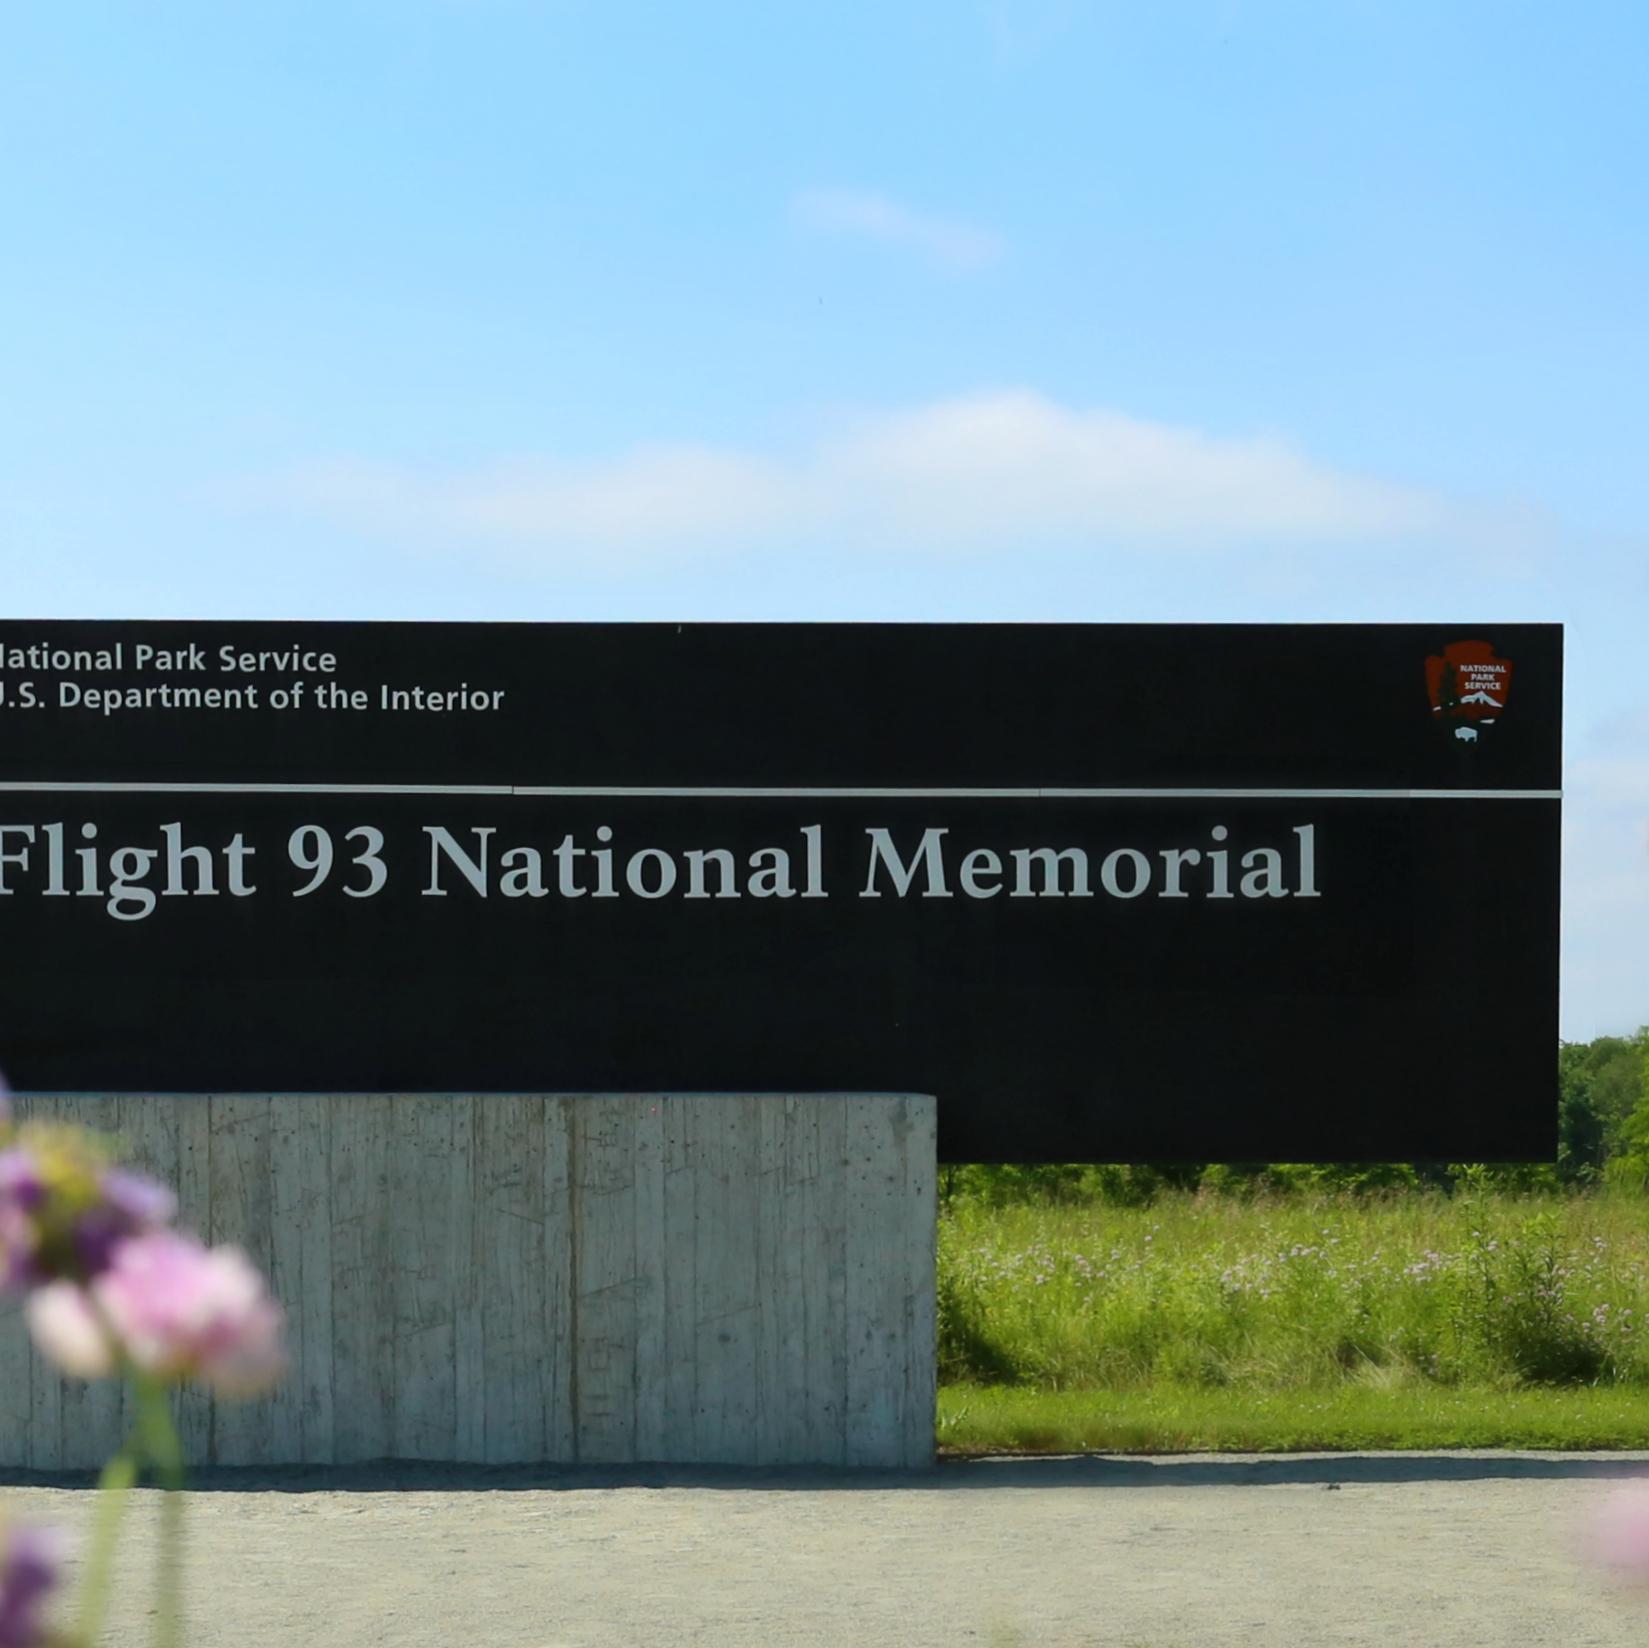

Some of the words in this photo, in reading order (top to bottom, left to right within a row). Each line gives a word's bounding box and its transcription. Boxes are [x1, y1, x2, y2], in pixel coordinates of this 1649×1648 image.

[135, 642, 207, 671] Park
[219, 643, 337, 673] Service
[1460, 664, 1506, 673] NATIONAL
[1471, 673, 1495, 681] PARK
[1464, 681, 1501, 690] SERVICE
[59, 681, 259, 717] Department
[269, 680, 304, 710] of
[313, 681, 369, 711] the
[381, 682, 505, 712] Interior
[287, 824, 388, 898] 93
[421, 823, 829, 899] National
[858, 823, 1321, 899] Memorial
